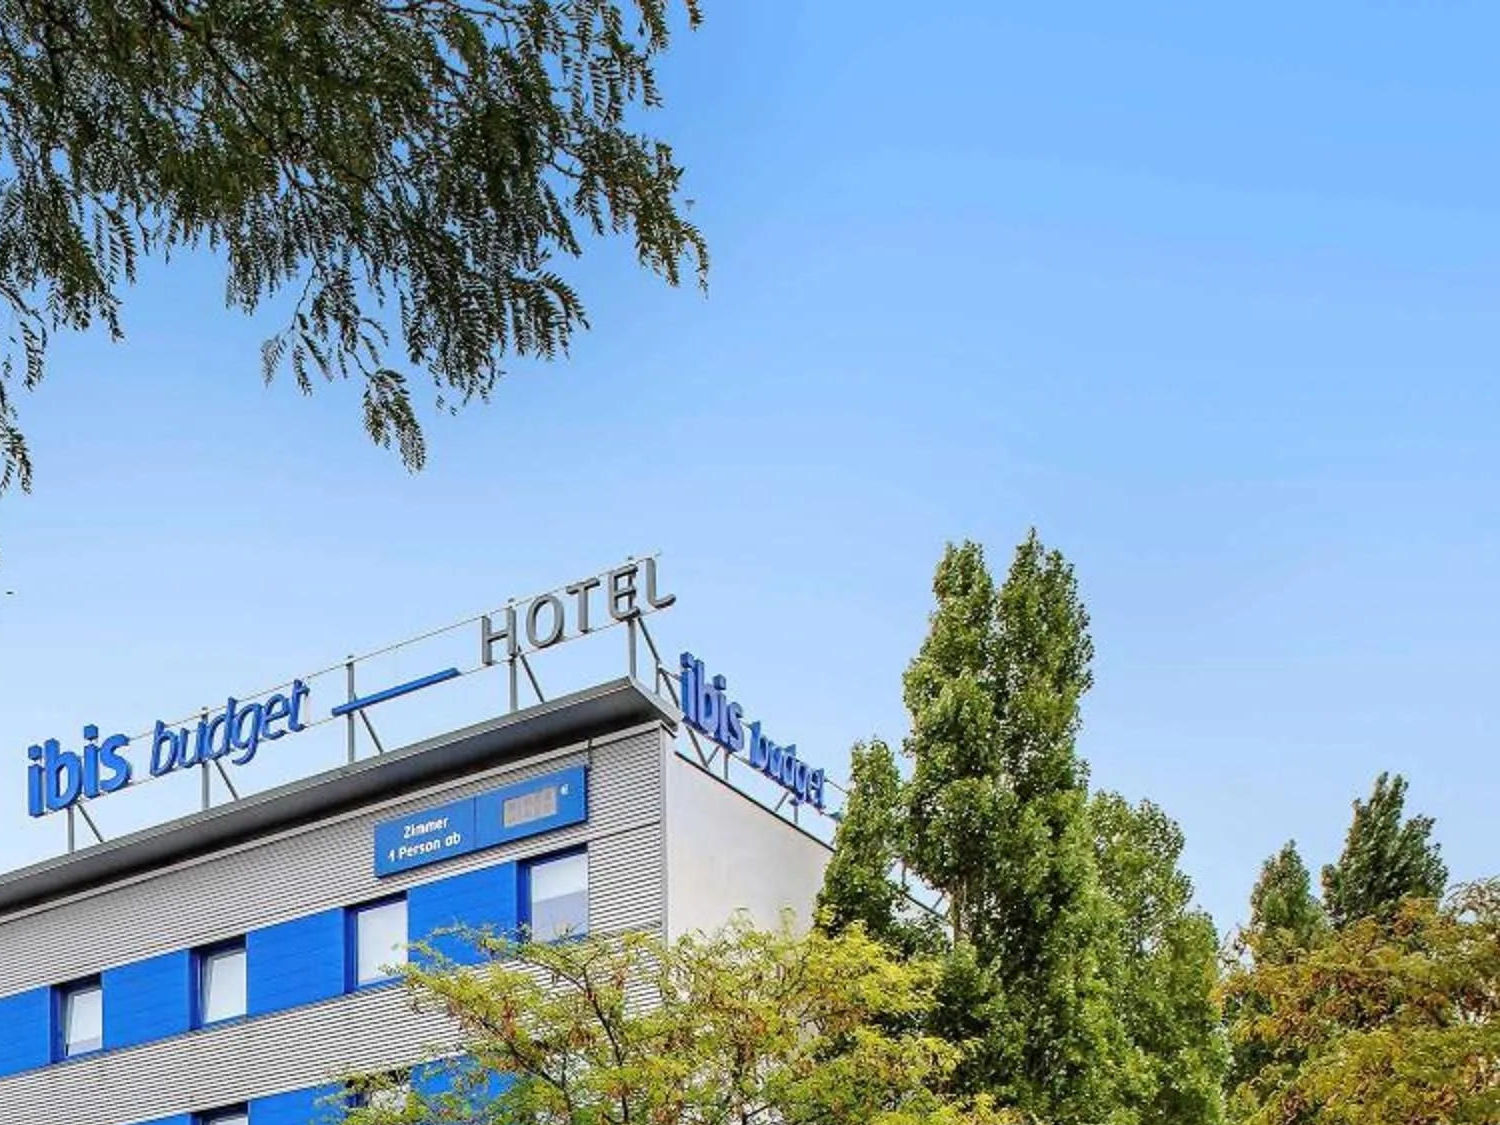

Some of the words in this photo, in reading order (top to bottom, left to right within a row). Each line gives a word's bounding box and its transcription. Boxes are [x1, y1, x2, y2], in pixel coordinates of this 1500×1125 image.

[481, 557, 677, 666] HOTEL
[27, 723, 133, 818] ibis
[150, 678, 310, 767] budget
[679, 651, 745, 752] ibis
[749, 719, 825, 808] budget
[387, 848, 395, 863] 1
[398, 839, 441, 860] Person
[445, 831, 461, 848] ab
[403, 816, 449, 839] Zimmer
